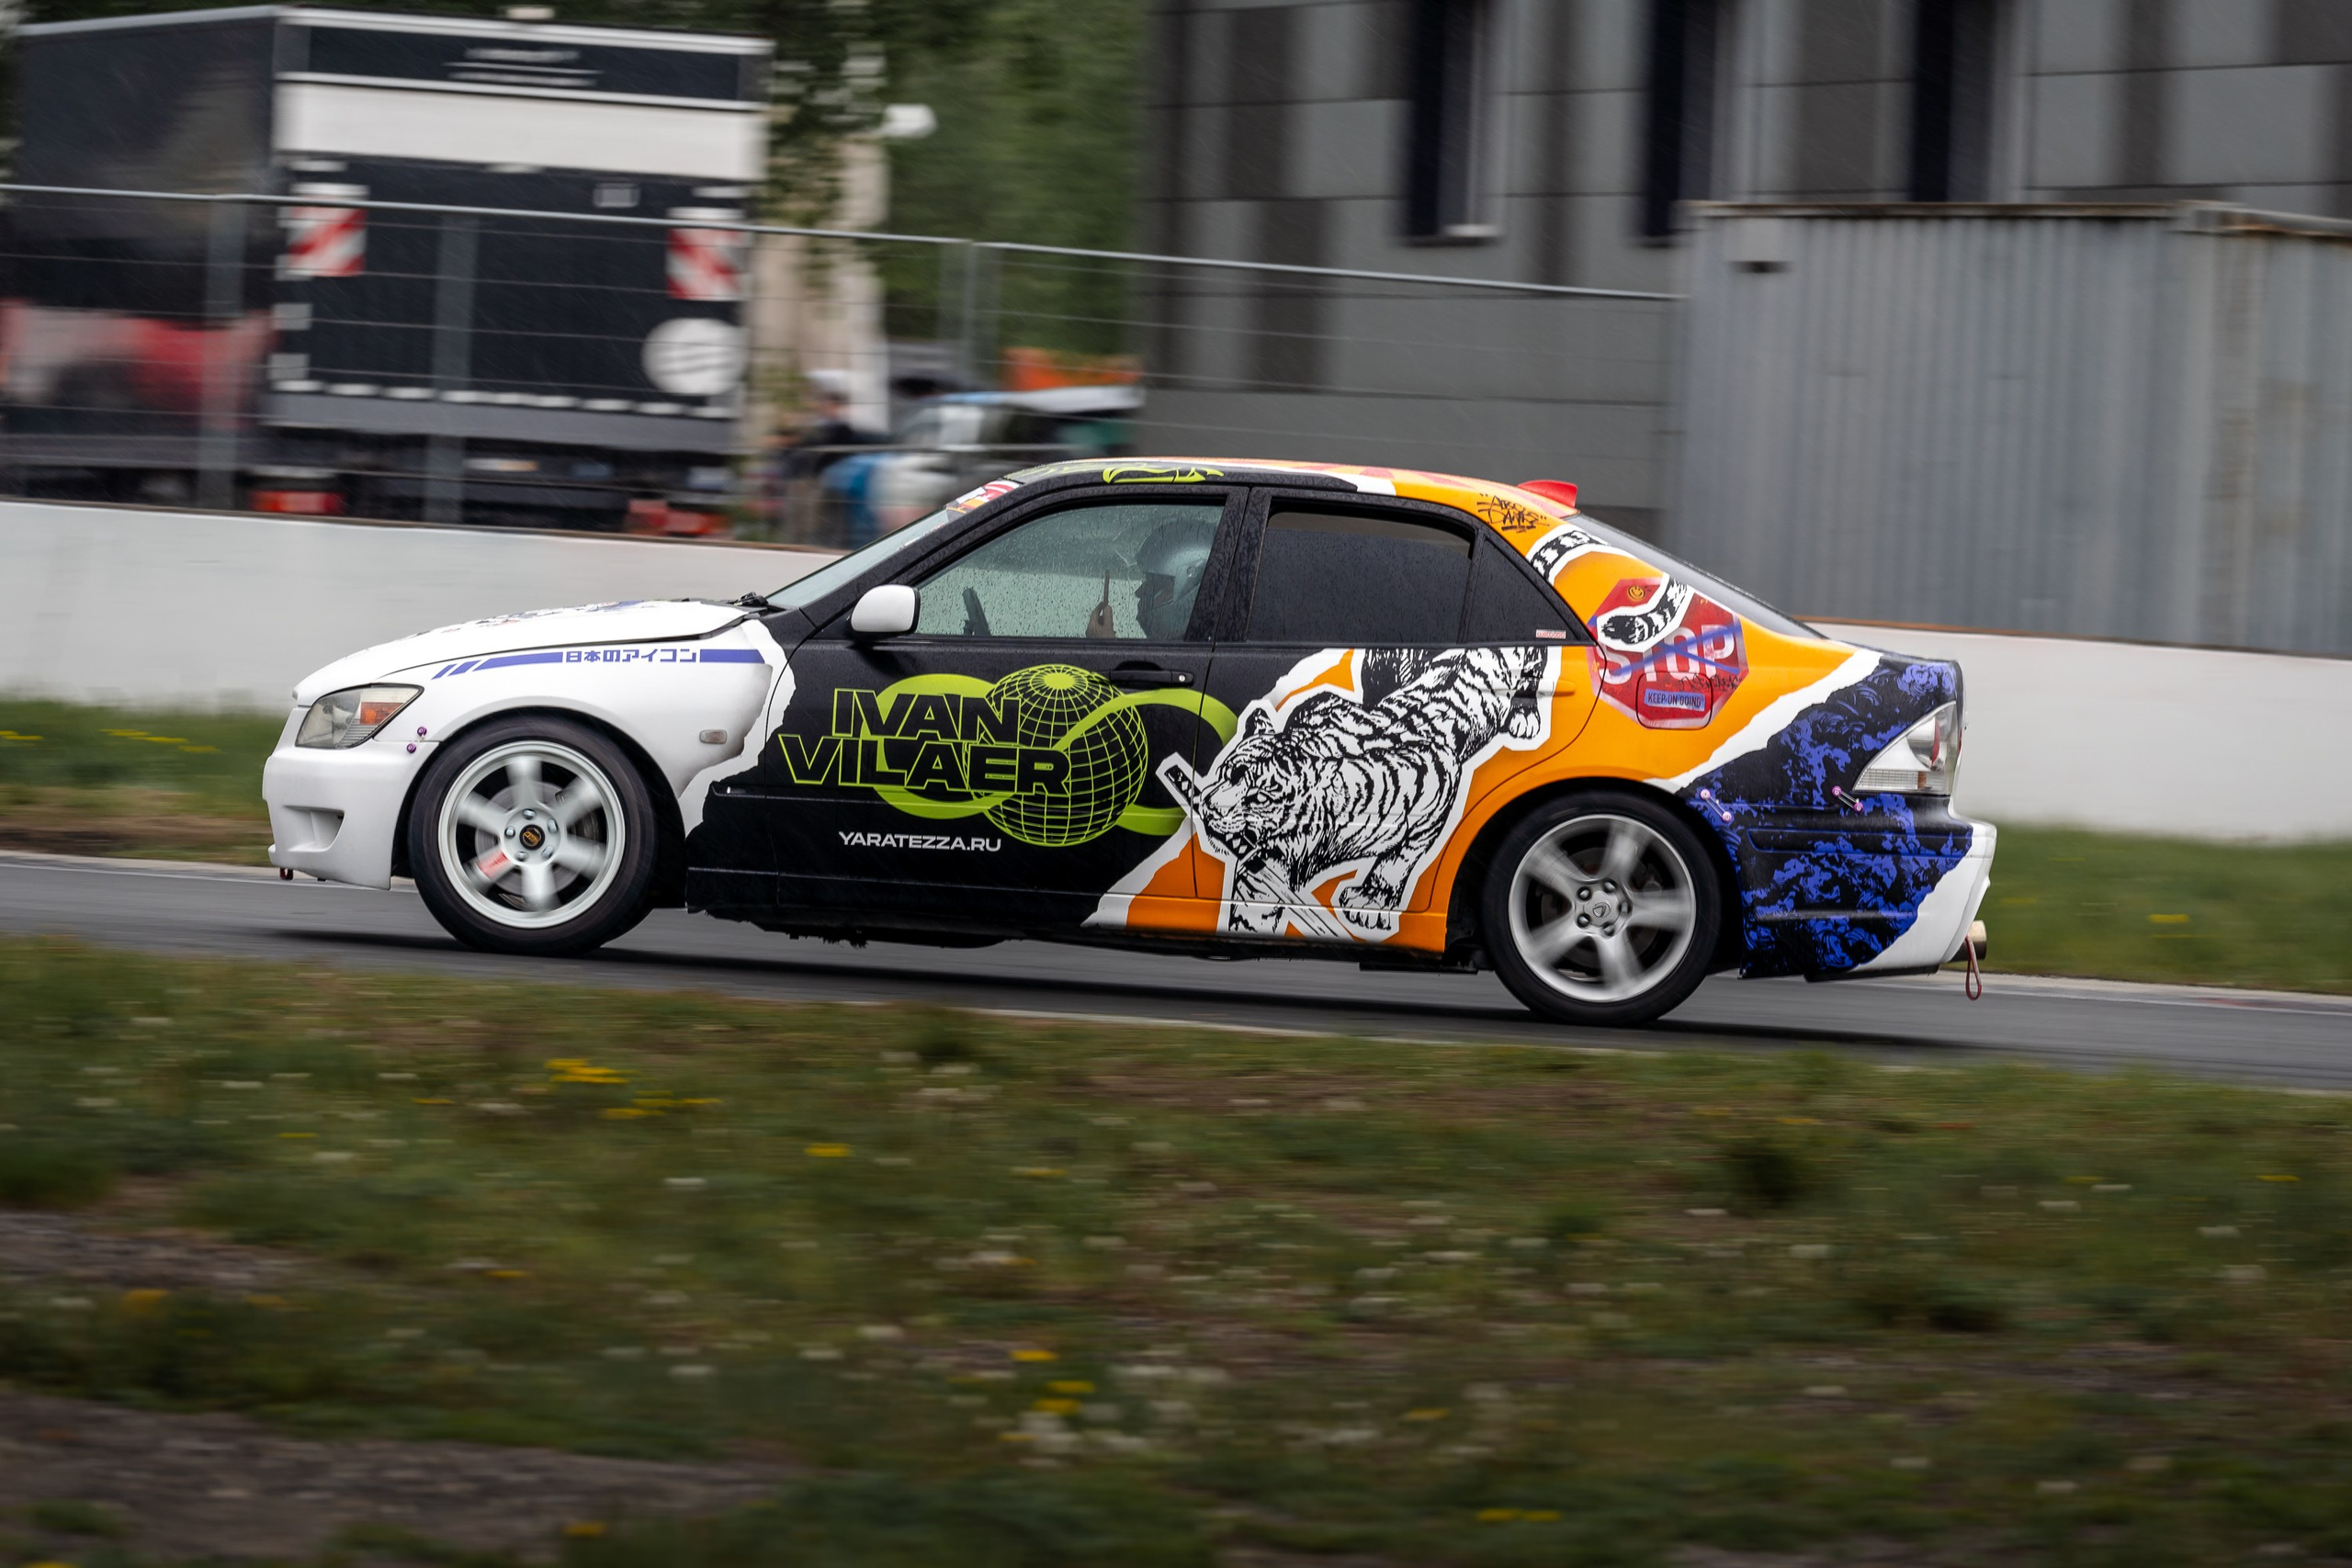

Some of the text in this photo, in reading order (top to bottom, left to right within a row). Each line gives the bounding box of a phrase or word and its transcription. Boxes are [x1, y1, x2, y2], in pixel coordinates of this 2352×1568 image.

[566, 649, 696, 663] 日本のアイコン
[1647, 692, 1702, 708] KEEP ON GOING
[831, 688, 1022, 745] IVAN
[777, 734, 1073, 797] VILAER
[838, 831, 1002, 852] YARATEZZA.RU
